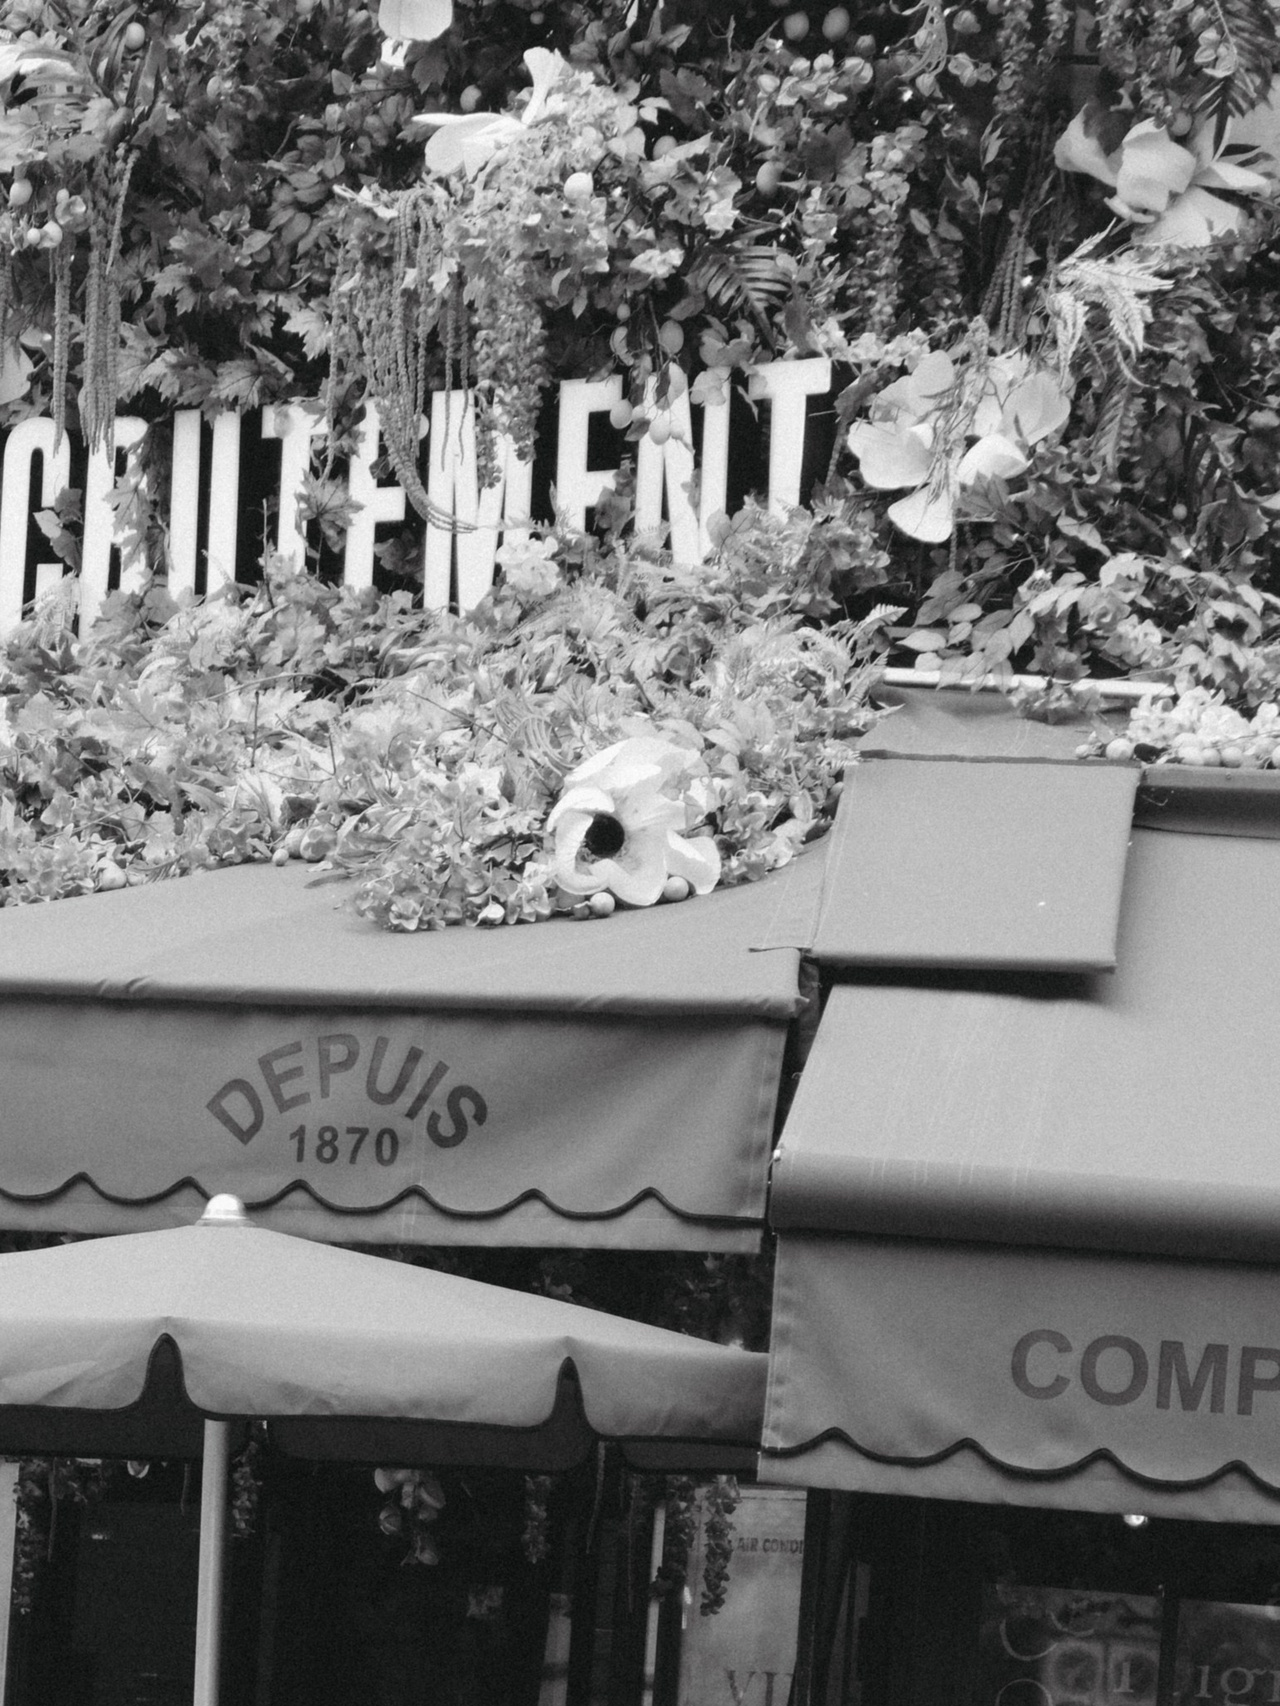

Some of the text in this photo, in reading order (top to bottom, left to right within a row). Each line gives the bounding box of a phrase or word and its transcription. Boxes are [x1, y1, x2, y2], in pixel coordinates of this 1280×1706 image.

[206, 1032, 488, 1149] DEPUIS
[289, 1124, 399, 1167] 1870
[1011, 1328, 1280, 1416] COMP
[737, 1536, 760, 1552] AIR
